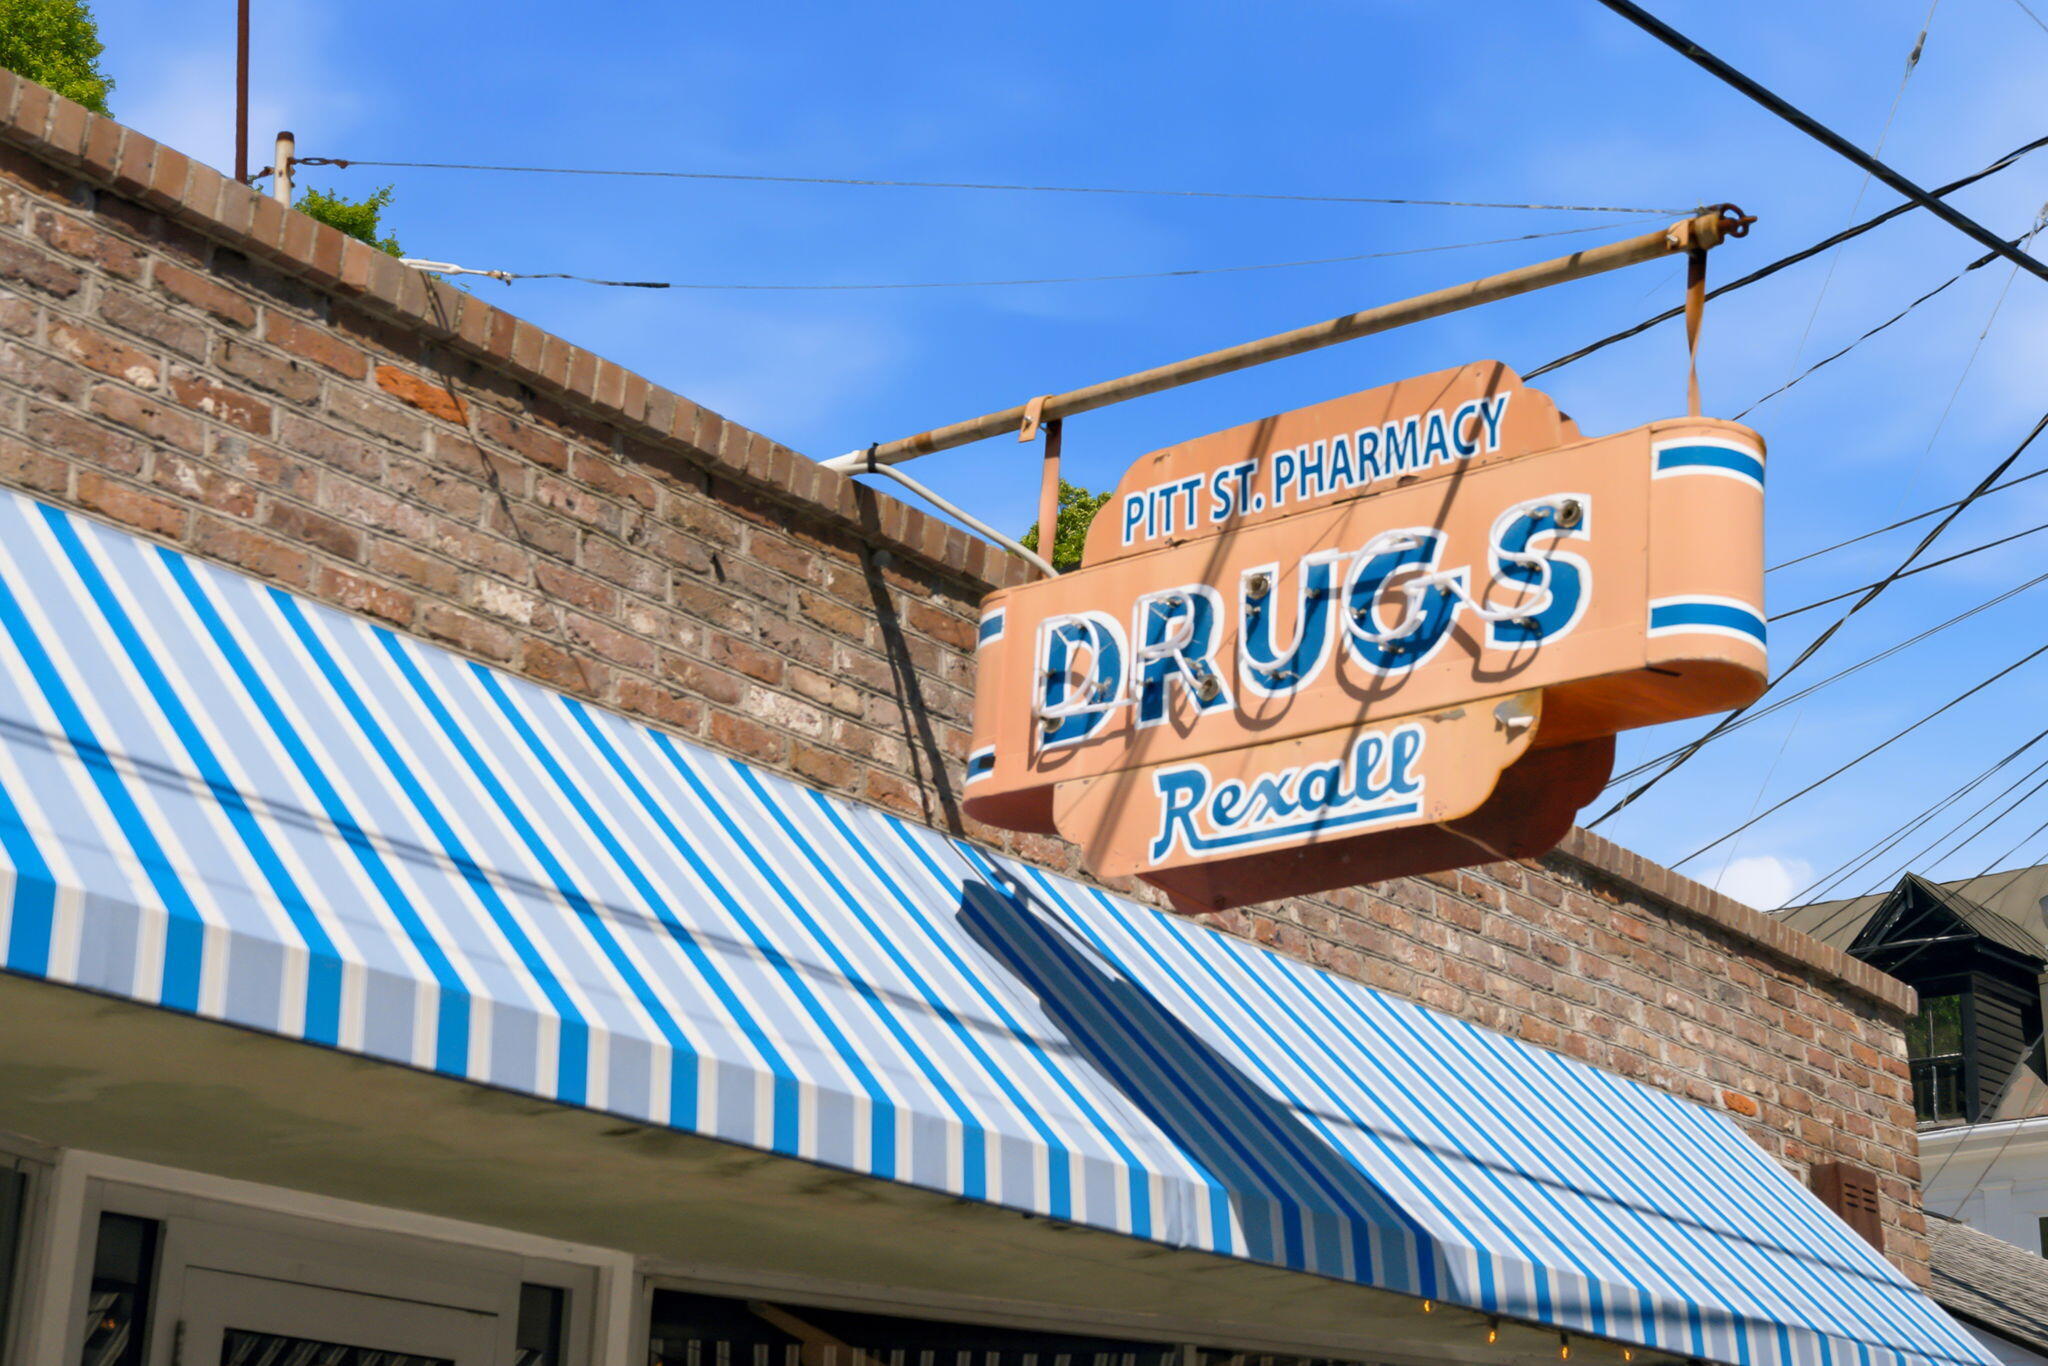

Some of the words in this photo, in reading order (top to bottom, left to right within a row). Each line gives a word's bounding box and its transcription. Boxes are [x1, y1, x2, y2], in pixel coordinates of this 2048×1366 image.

[1122, 470, 1205, 545] PITT
[1209, 457, 1265, 524] ST.
[1272, 391, 1511, 505] PHARMACY
[1035, 494, 1593, 752] DRUGS
[1149, 722, 1427, 866] Rexall
